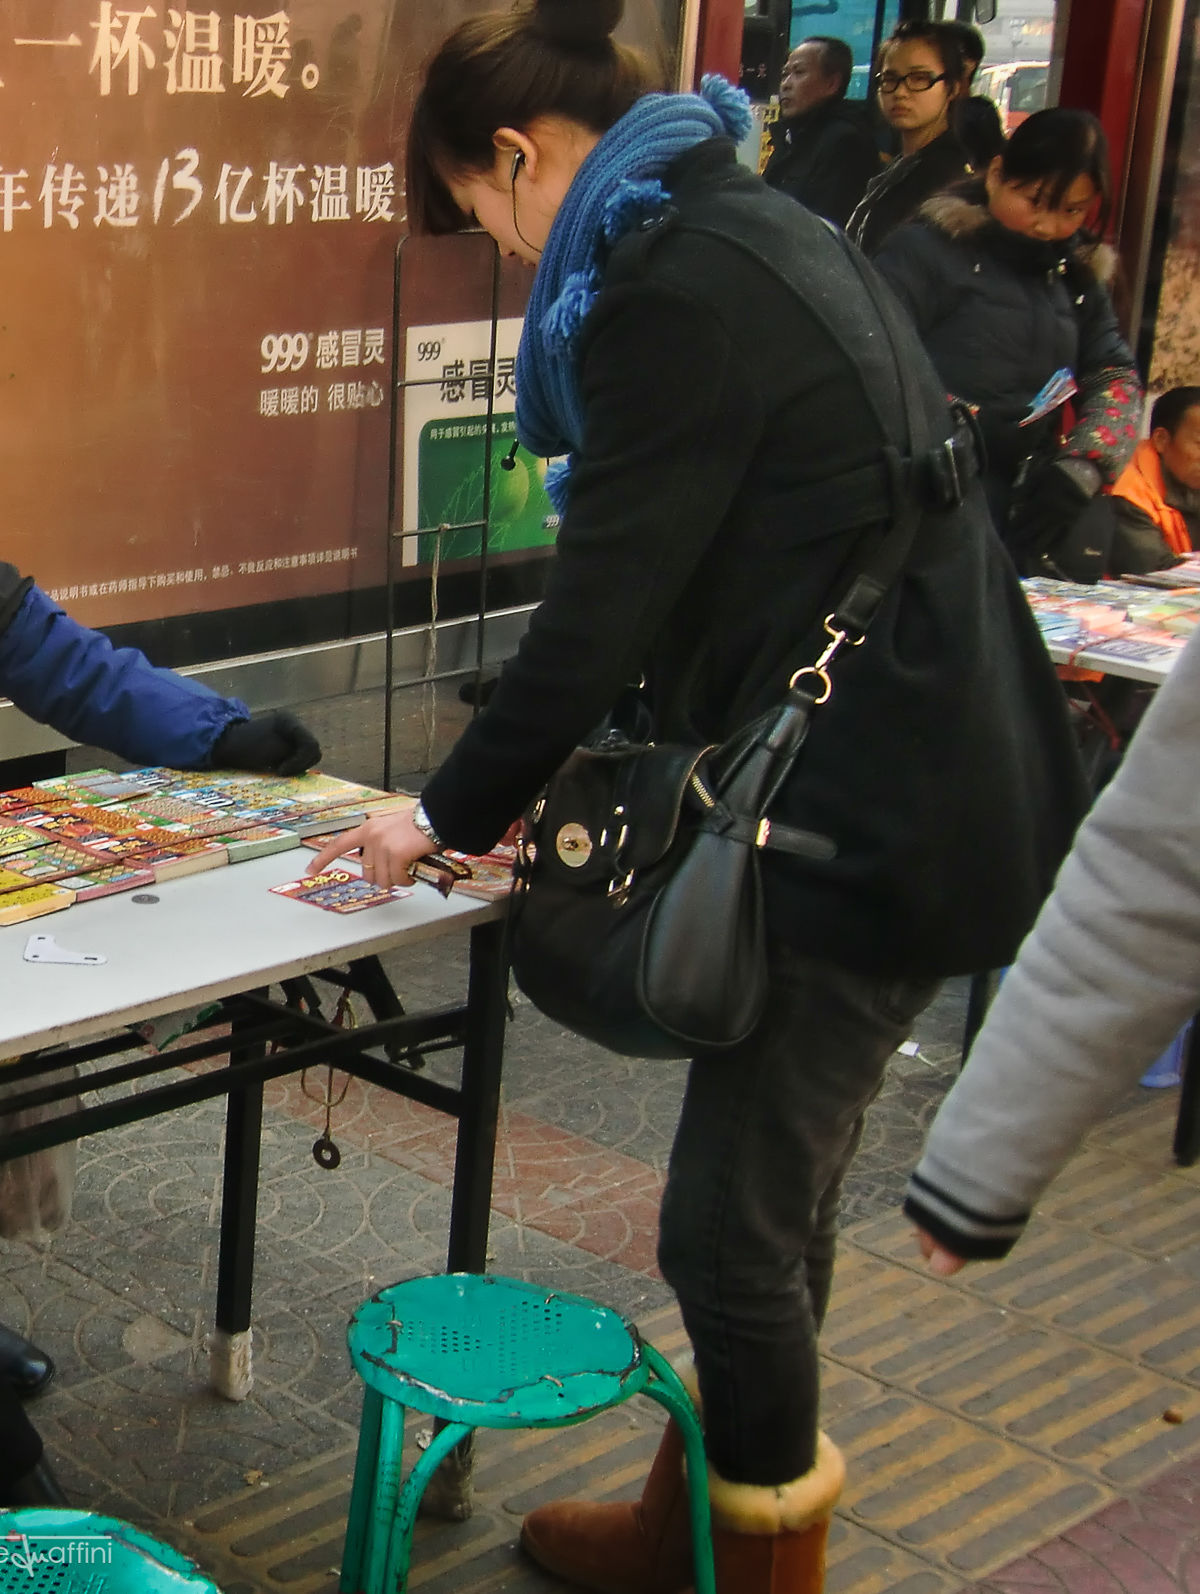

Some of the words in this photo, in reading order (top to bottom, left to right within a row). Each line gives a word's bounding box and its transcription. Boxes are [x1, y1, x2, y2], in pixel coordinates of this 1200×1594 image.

[315, 328, 385, 368] 感冒灵
[259, 385, 319, 417] 暖暖的
[327, 380, 384, 411] 很贴心
[440, 357, 516, 402] 感冒灵
